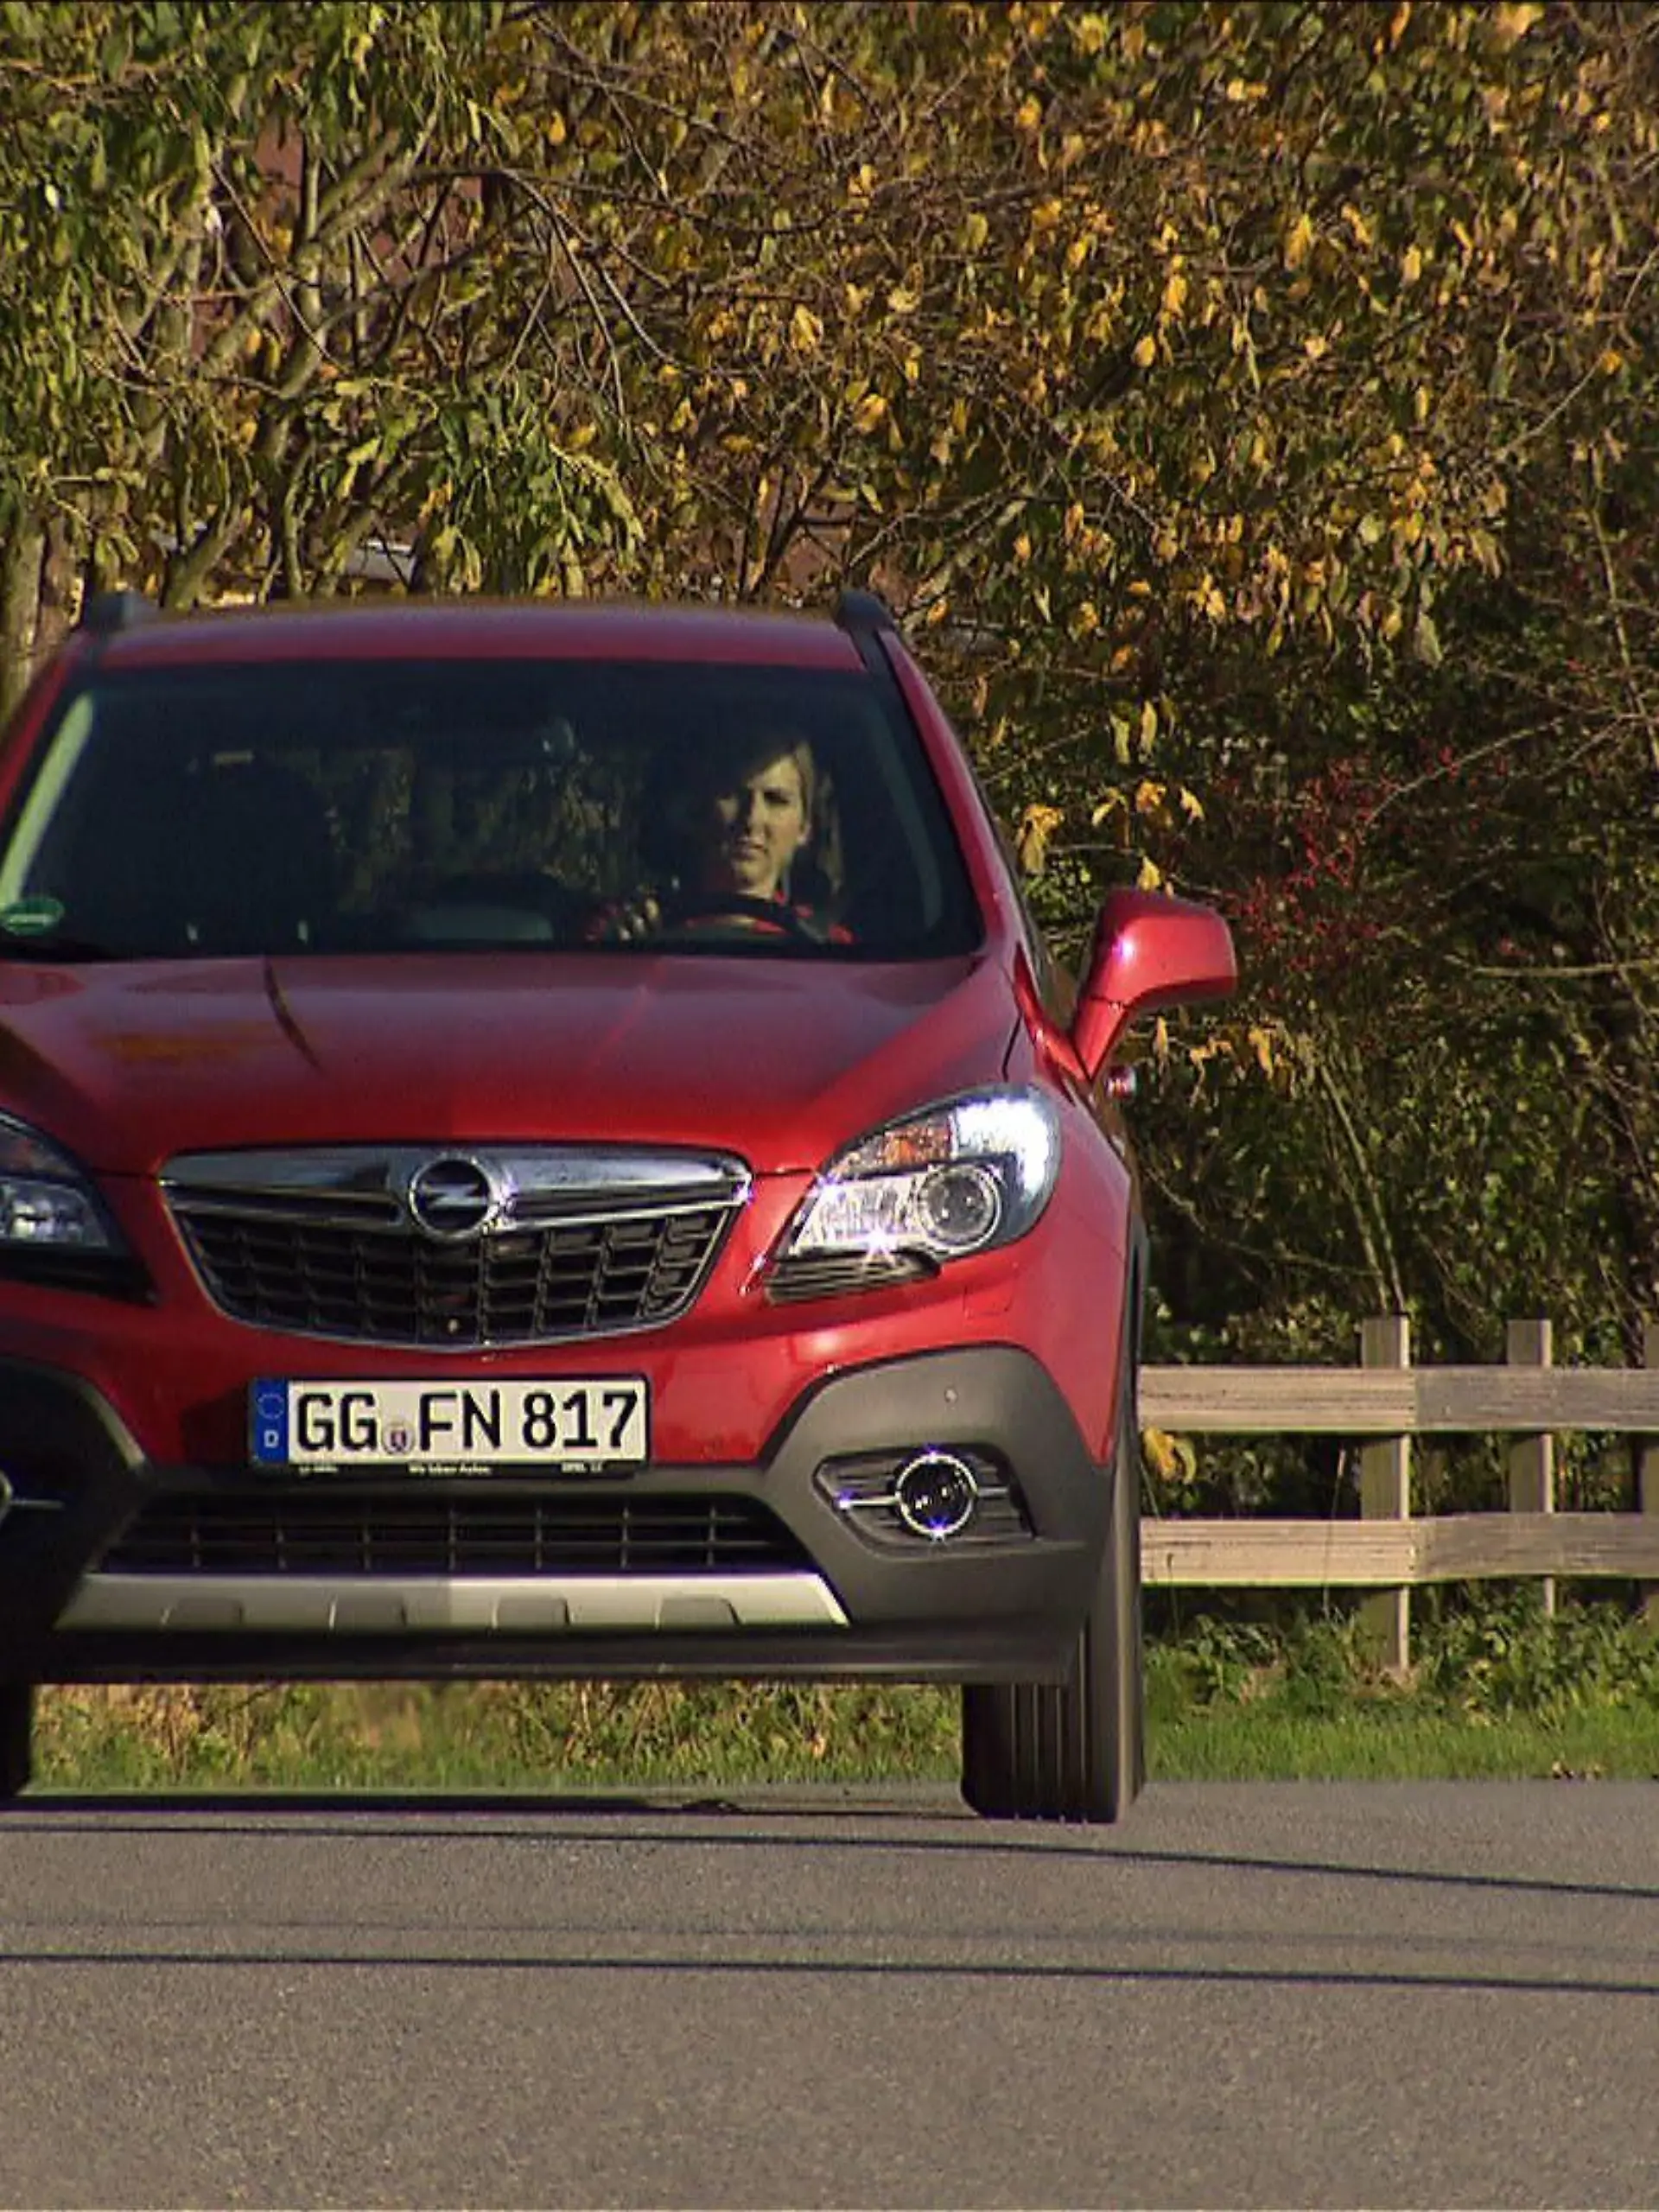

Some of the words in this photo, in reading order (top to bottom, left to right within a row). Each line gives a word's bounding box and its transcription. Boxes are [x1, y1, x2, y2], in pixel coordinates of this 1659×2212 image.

[296, 1392, 378, 1452] GG
[419, 1390, 501, 1451] FN
[522, 1390, 639, 1448] 817
